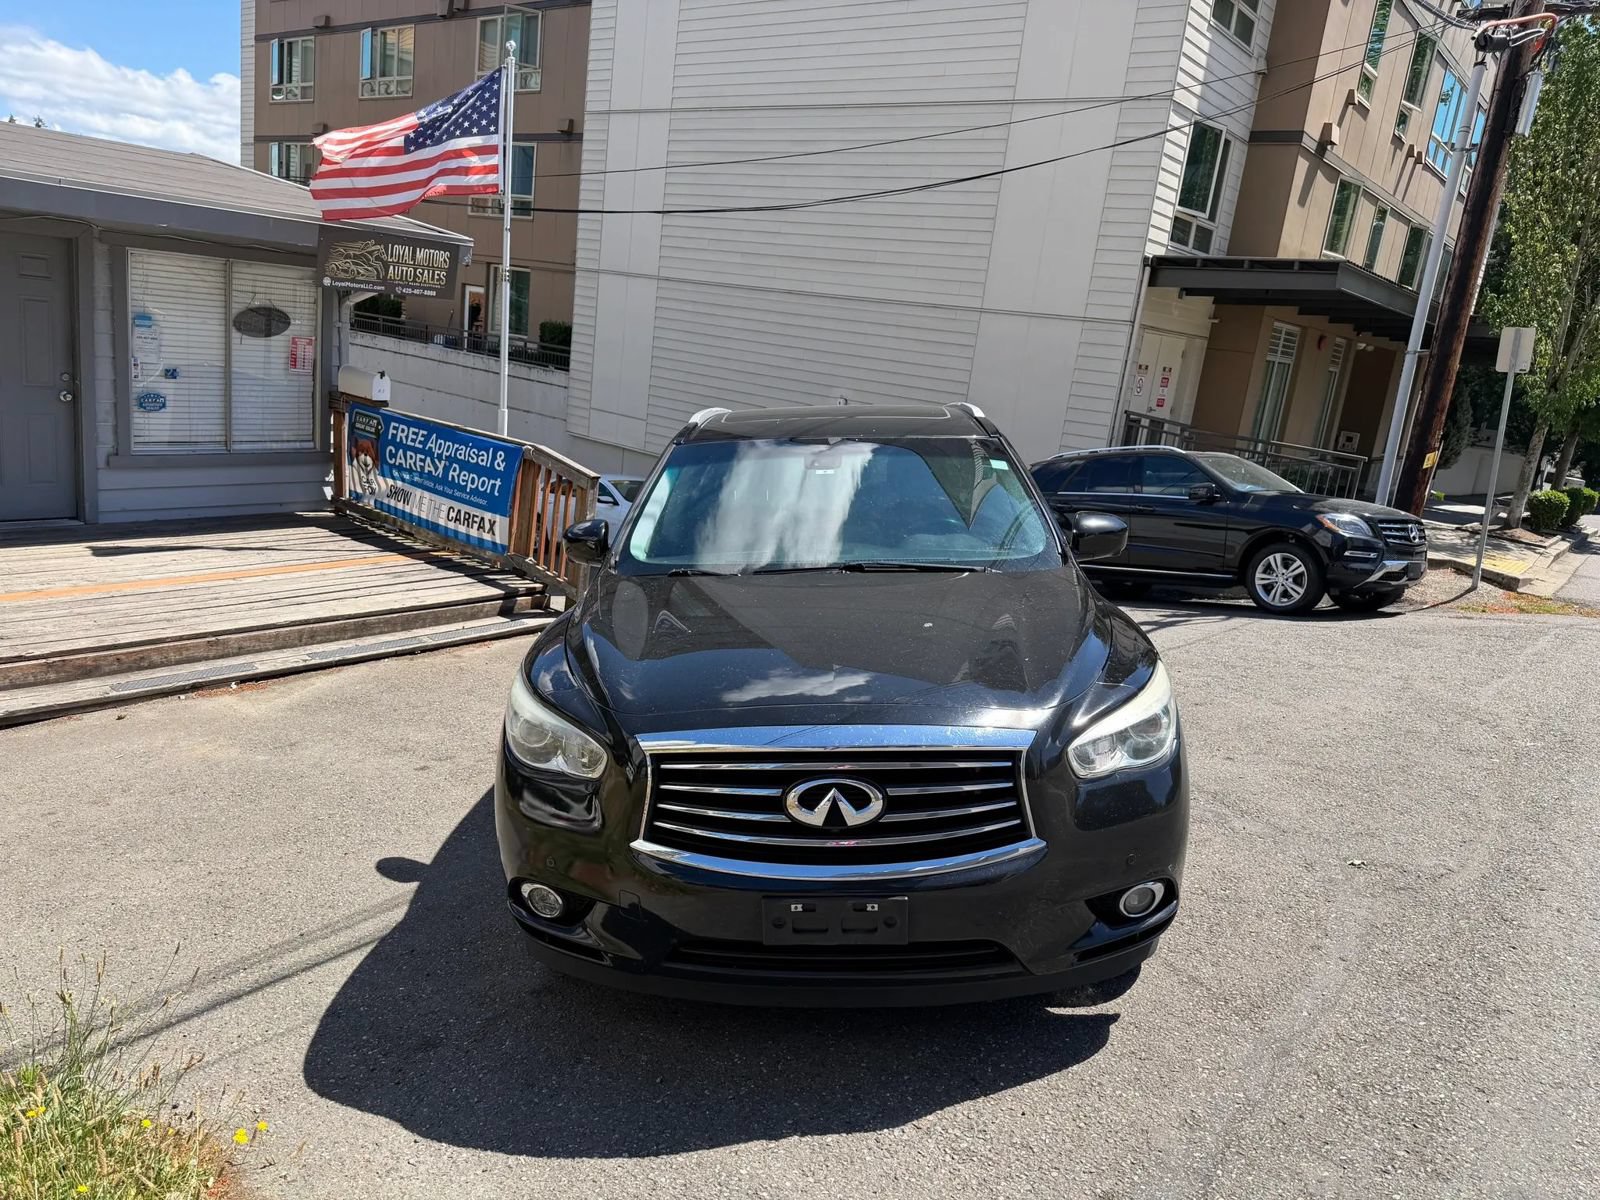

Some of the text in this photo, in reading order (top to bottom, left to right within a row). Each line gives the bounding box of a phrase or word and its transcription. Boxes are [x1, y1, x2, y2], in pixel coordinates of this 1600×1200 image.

[387, 243, 450, 269] LOYAL MOTORS
[332, 280, 385, 291] LoyalMotorsLLC.com
[387, 265, 447, 285] AUTO SALES
[388, 421, 506, 472] FREE Appraisal &
[448, 463, 502, 497] Report
[453, 489, 470, 500] Service
[386, 484, 497, 537] SHOW ME THE CARFAX
